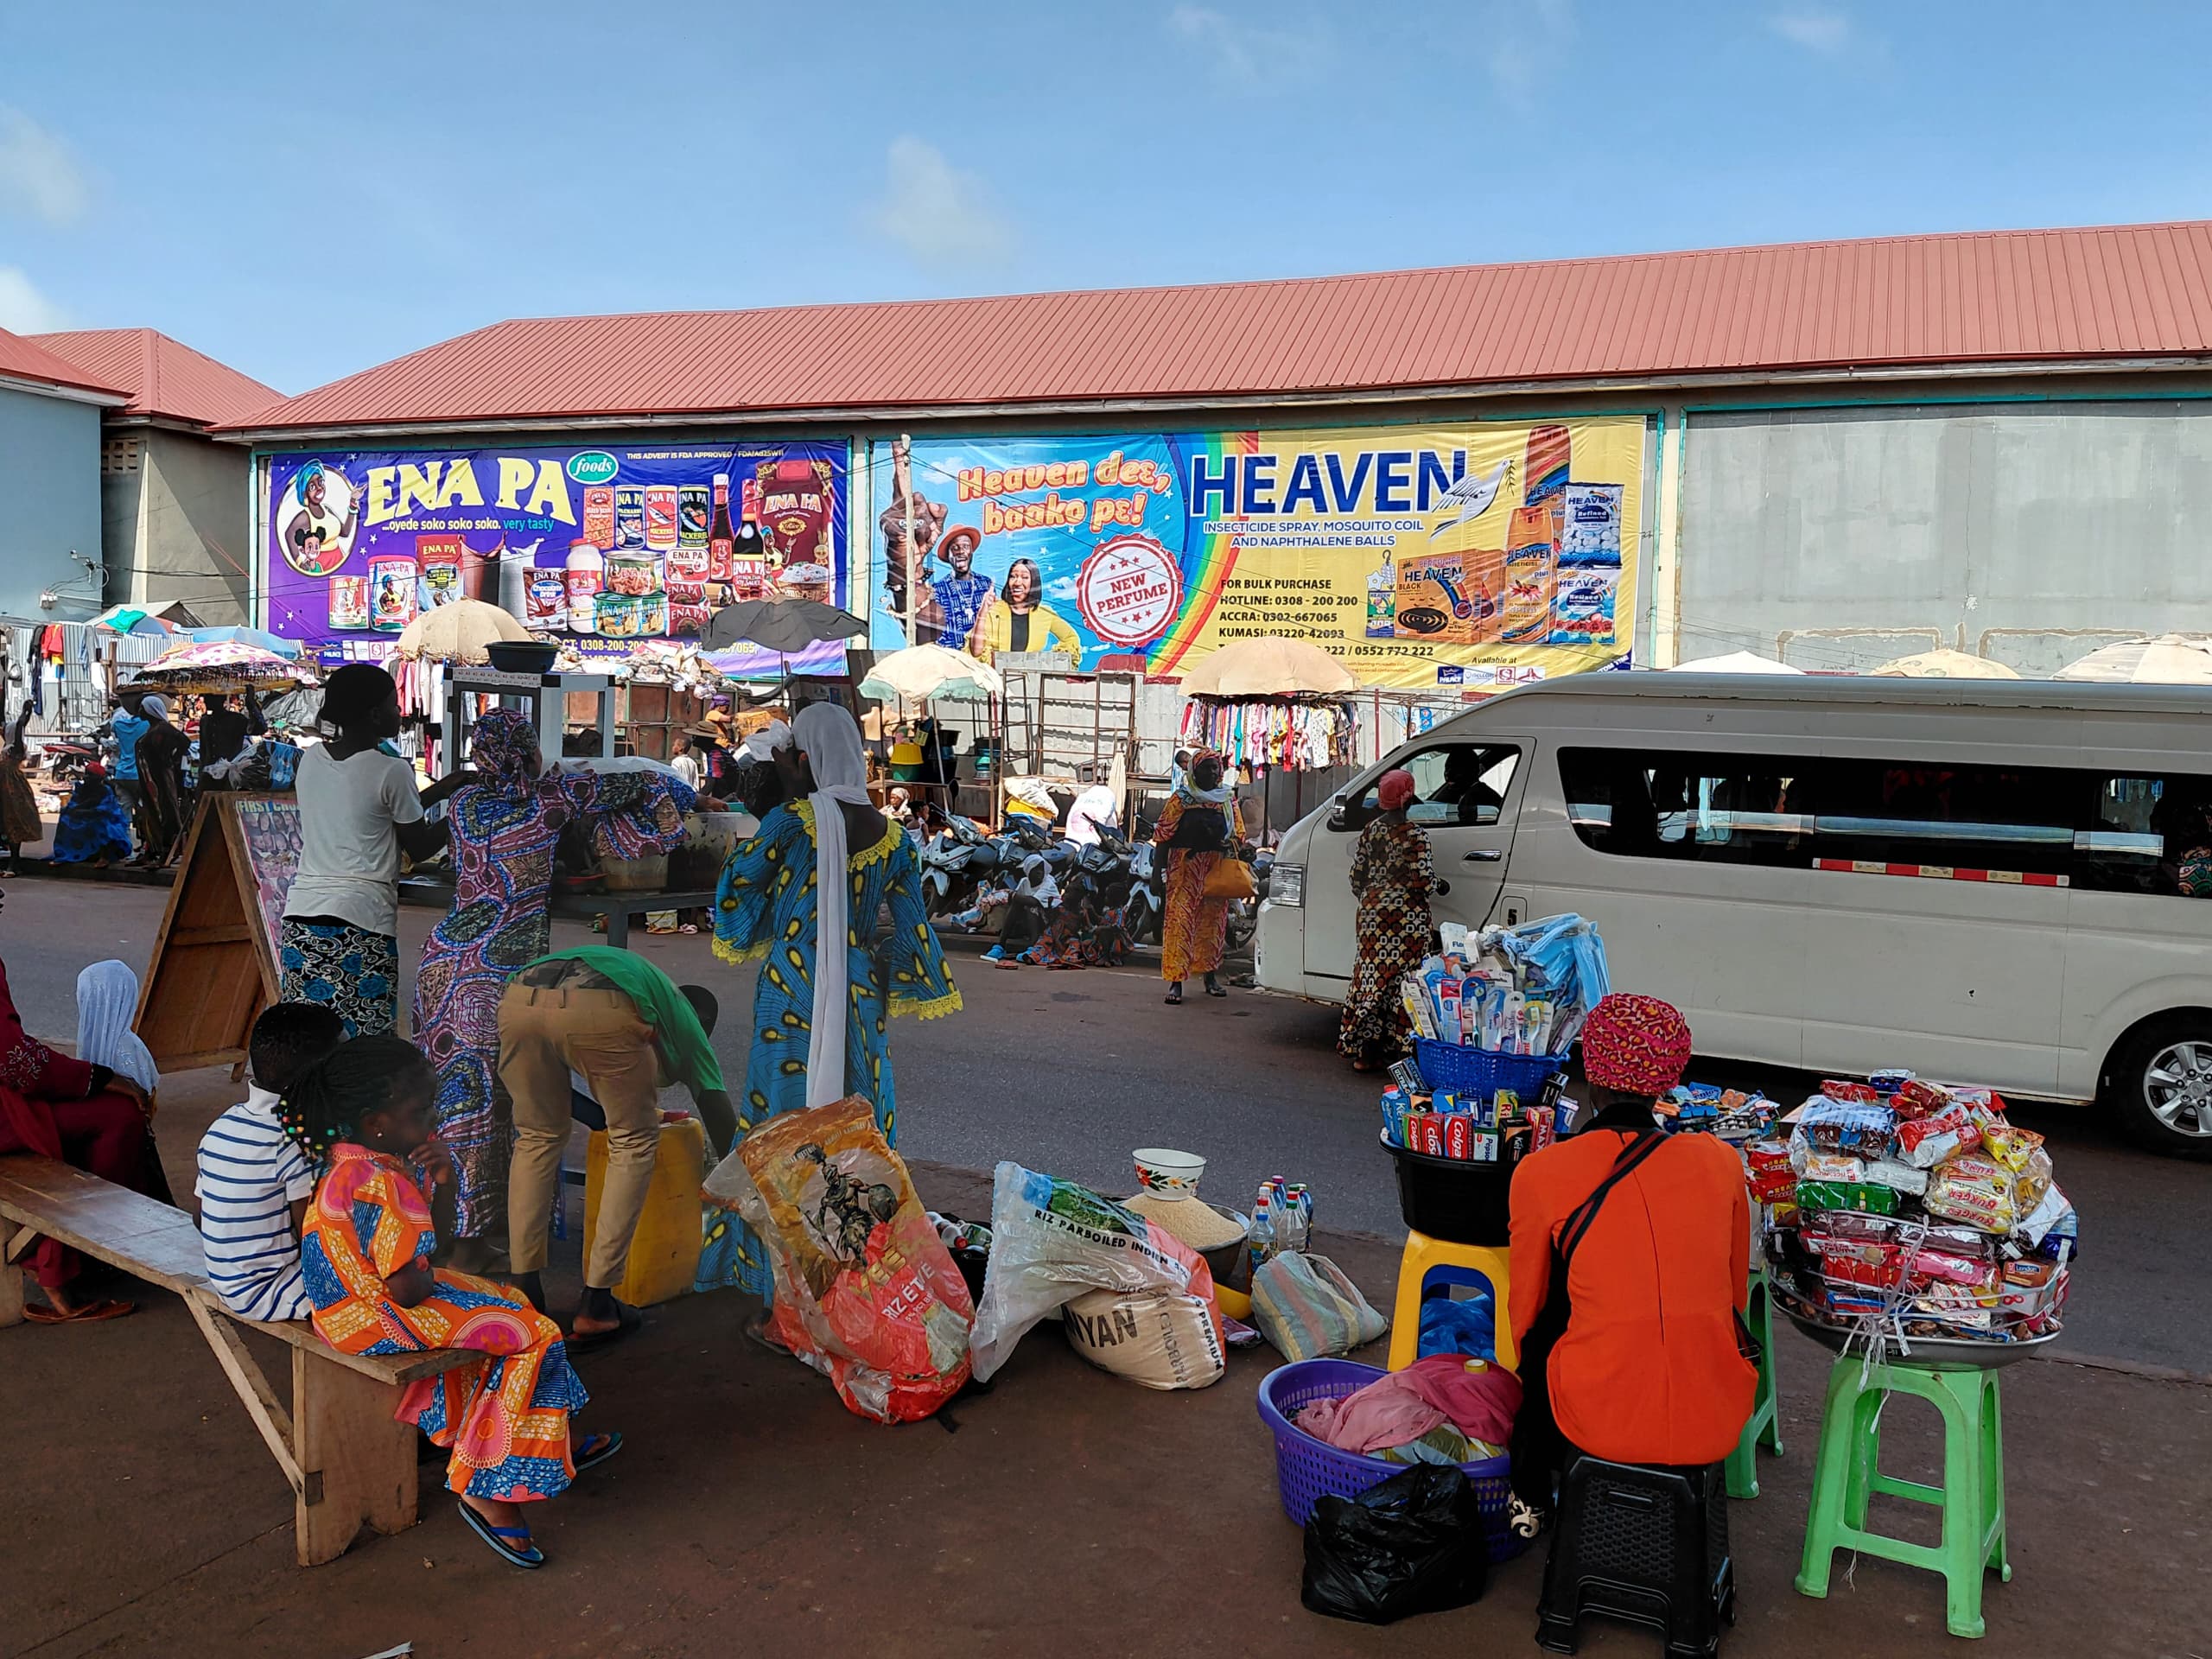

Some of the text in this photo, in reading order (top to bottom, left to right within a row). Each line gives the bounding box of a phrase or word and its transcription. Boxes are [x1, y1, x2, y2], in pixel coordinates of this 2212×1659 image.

[572, 455, 613, 477] foods
[957, 460, 1089, 501] Heaven
[1190, 448, 1468, 517] HEAVEN
[364, 457, 577, 526] ENA PA
[696, 493, 708, 505] PA
[763, 493, 799, 515] ENA
[801, 493, 823, 513] PA
[983, 493, 1088, 535] baako
[421, 518, 446, 531] soko
[448, 518, 473, 531] soko
[474, 518, 501, 531] soko.
[503, 518, 525, 532] very
[527, 518, 555, 532] tasty
[1204, 520, 1424, 533] INSECTICIDE SPRAY, MOSQUITO COIL
[1231, 536, 1395, 547] AND NAPHTHALENE BALLS
[423, 544, 457, 555] ENA PA
[533, 571, 561, 581] ENA PA
[620, 567, 651, 578] ENA PA
[1404, 567, 1462, 582] HEAVEN
[667, 584, 698, 596] ENA PA
[1109, 573, 1147, 594] NEW
[1220, 579, 1332, 589] FOR BULK PURCHASE
[1096, 582, 1168, 613] PERFUME
[1220, 595, 1273, 606] HOTLINE:
[1275, 596, 1303, 606] 0308
[1313, 596, 1334, 606] 200
[1336, 596, 1358, 606] 200
[601, 604, 632, 616] ENA PA
[671, 607, 704, 621] ENA PA
[1219, 612, 1338, 622] ACCRA: 0302-667065
[1218, 627, 1268, 638] KUMASI:
[1355, 645, 1384, 656] 0552
[1387, 645, 1408, 656] 772
[1411, 645, 1433, 656] 222
[238, 800, 270, 812] FIRST
[1507, 909, 1517, 926] 5
[1948, 1188, 1998, 1211] BURGER
[1034, 1209, 1054, 1224] RIZ
[1058, 1220, 1127, 1248] PARBOILED
[1131, 1241, 1168, 1265] INDIEN
[881, 1296, 908, 1321] RIZ
[1198, 1311, 1224, 1370] PREMIUM
